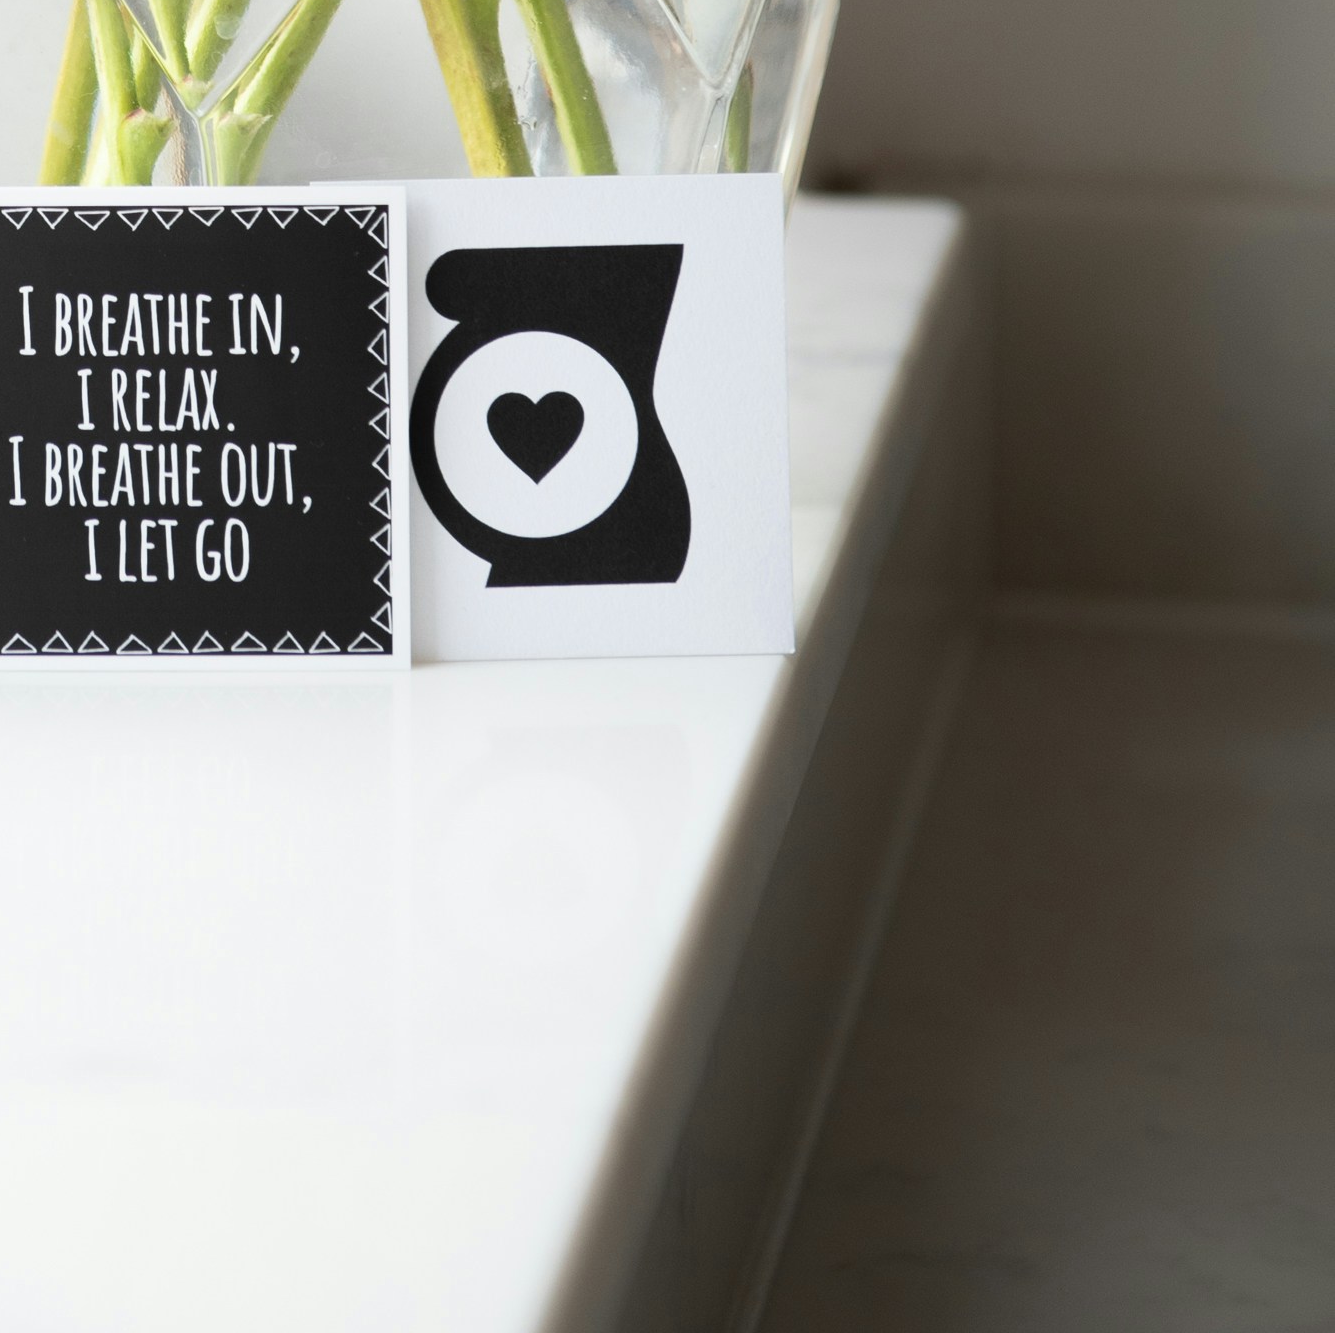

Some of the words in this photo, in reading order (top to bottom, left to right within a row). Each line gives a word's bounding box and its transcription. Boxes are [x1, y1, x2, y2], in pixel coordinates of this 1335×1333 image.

[19, 286, 36, 355] I
[55, 293, 213, 356] BREATHE
[229, 293, 299, 363] IN,
[77, 369, 95, 430] I
[112, 368, 235, 432] RELAX.
[9, 436, 26, 506] I
[45, 443, 203, 507] BREATHE
[221, 442, 312, 513] OUT,
[85, 519, 102, 581] I
[119, 519, 178, 582] LET
[196, 518, 249, 582] GO
